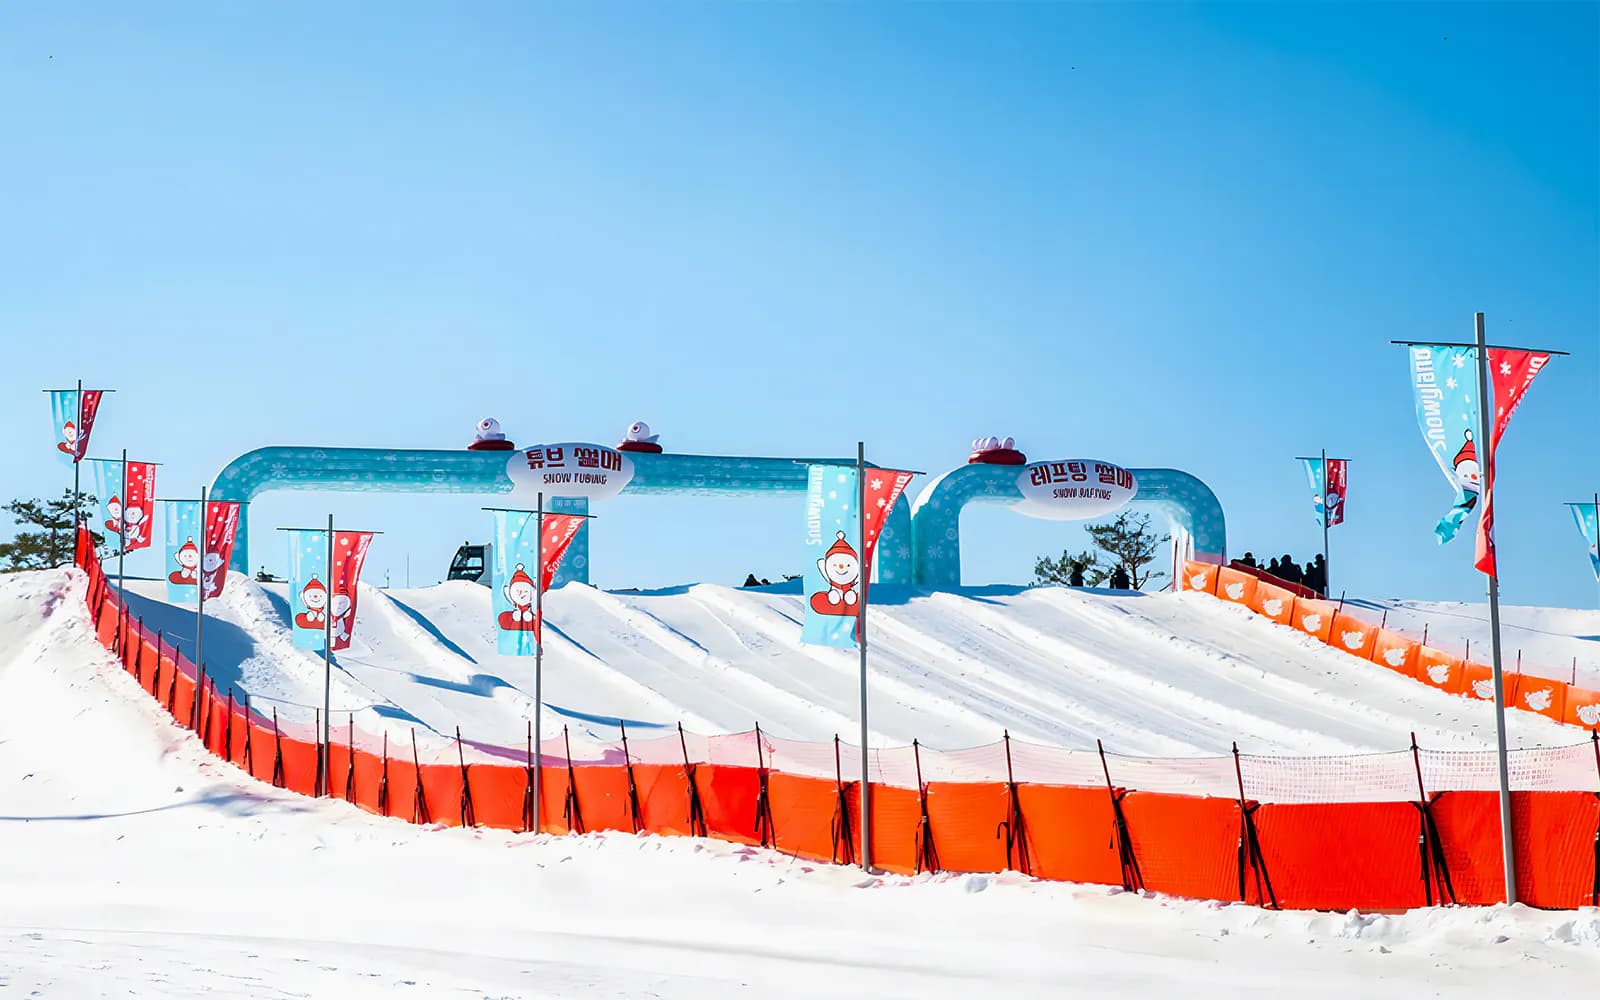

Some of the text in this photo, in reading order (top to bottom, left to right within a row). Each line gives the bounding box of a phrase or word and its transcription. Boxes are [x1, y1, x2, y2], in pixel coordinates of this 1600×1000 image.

[526, 447, 622, 472] 튜브 썰매
[543, 472, 572, 484] SNOW
[1029, 462, 1133, 490] 레프팅 썰매
